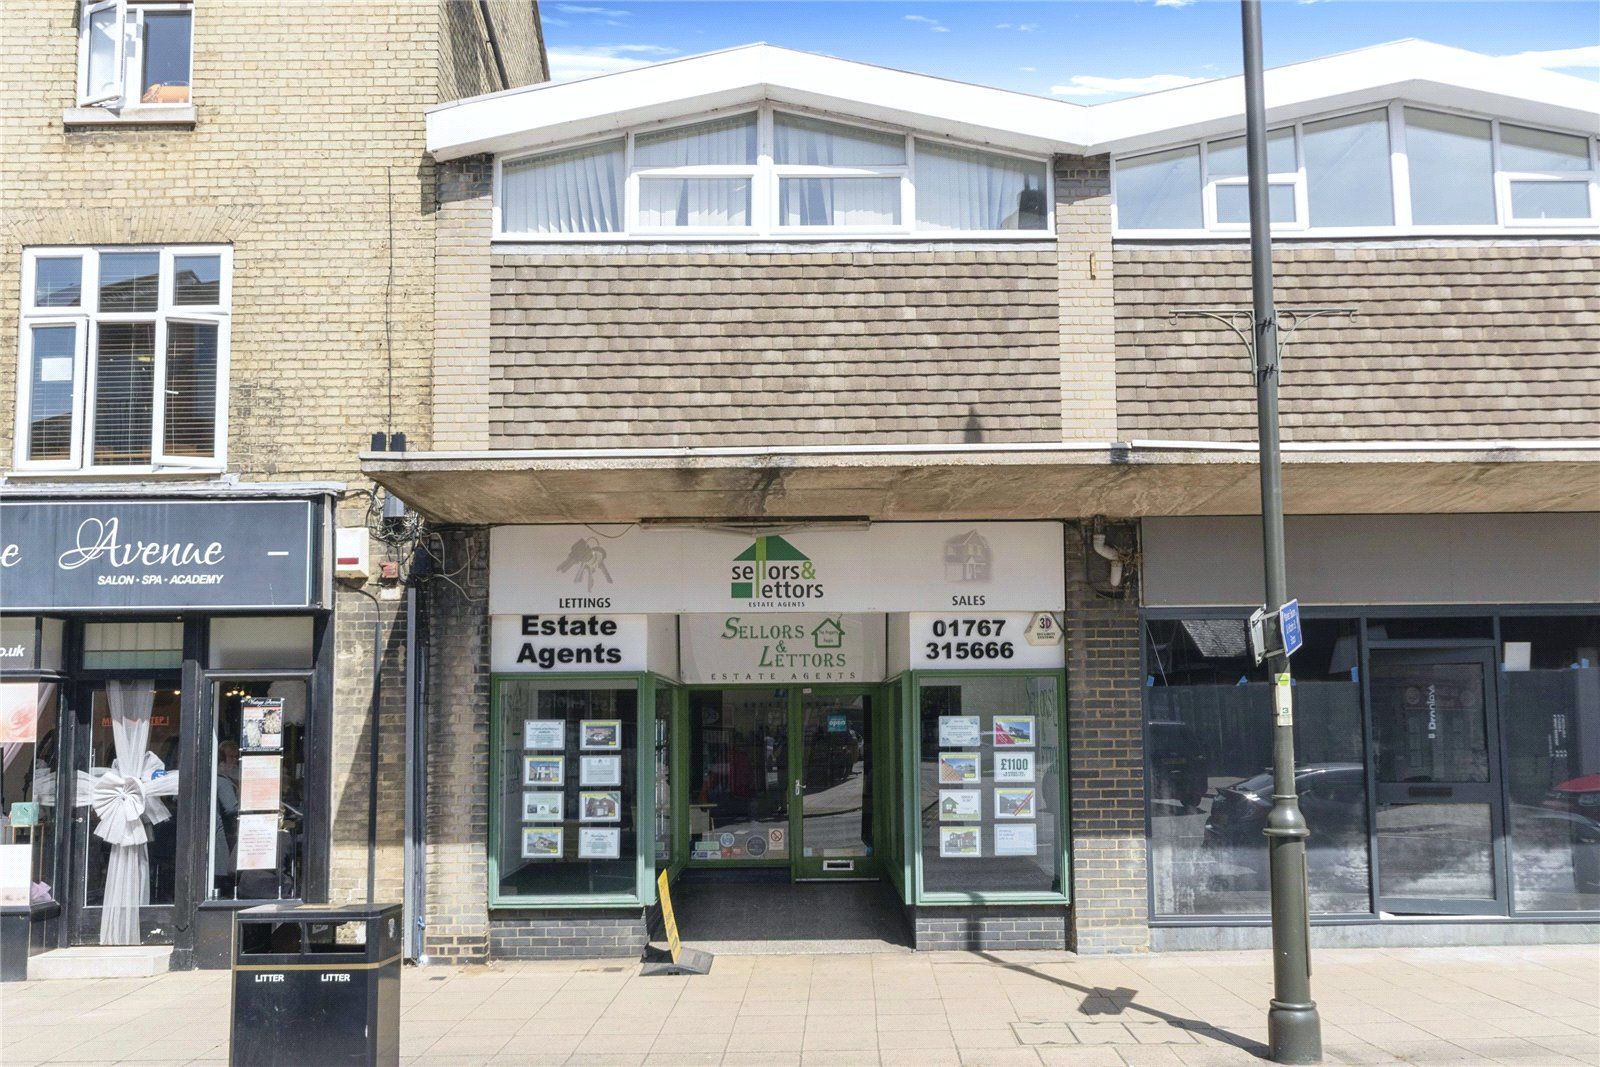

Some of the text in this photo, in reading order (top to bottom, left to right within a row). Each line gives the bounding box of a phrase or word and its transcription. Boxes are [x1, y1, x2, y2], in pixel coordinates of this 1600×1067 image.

[58, 517, 225, 569] Avenue
[97, 574, 225, 586] SALON SPA ACADEMY
[558, 597, 612, 609] LETTINGS
[951, 595, 986, 607] SALES
[521, 614, 618, 636] Estate
[721, 616, 806, 640] SELLORS
[932, 619, 1007, 637] 01767
[775, 640, 787, 653] &
[925, 642, 1015, 660] 315666
[516, 642, 623, 669] Agents
[758, 645, 847, 668] LETTORS
[710, 671, 856, 680] ESTATE AGENTS
[1000, 757, 1029, 771] £1100
[254, 974, 285, 983] LITTER
[320, 973, 351, 982] LITTER
